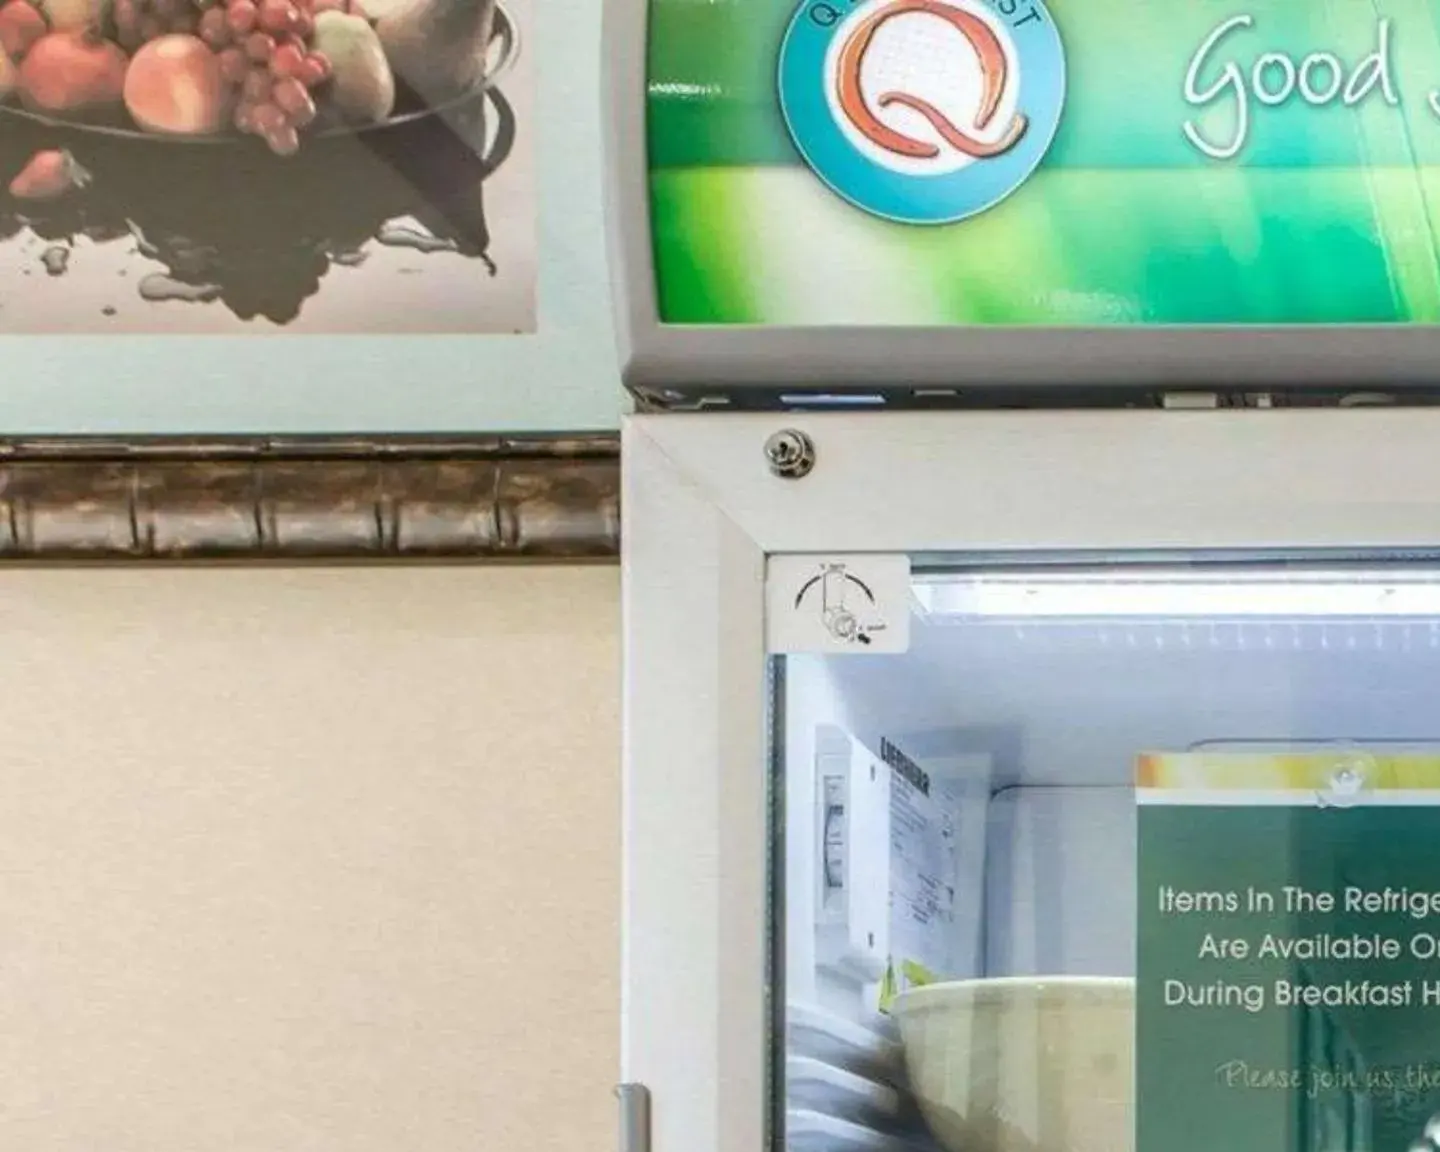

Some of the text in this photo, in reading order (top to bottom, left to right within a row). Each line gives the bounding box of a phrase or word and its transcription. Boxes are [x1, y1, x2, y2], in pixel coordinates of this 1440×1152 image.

[1183, 14, 1399, 158] Good
[1158, 886, 1239, 912] Items
[1248, 887, 1274, 912] In
[1281, 887, 1335, 912] The
[1198, 934, 1250, 959] Are
[1258, 933, 1401, 959] Available
[1164, 980, 1265, 1012] During
[1274, 980, 1413, 1006] Breakfast
[1214, 1058, 1301, 1088] Please
[1306, 1064, 1357, 1099] join
